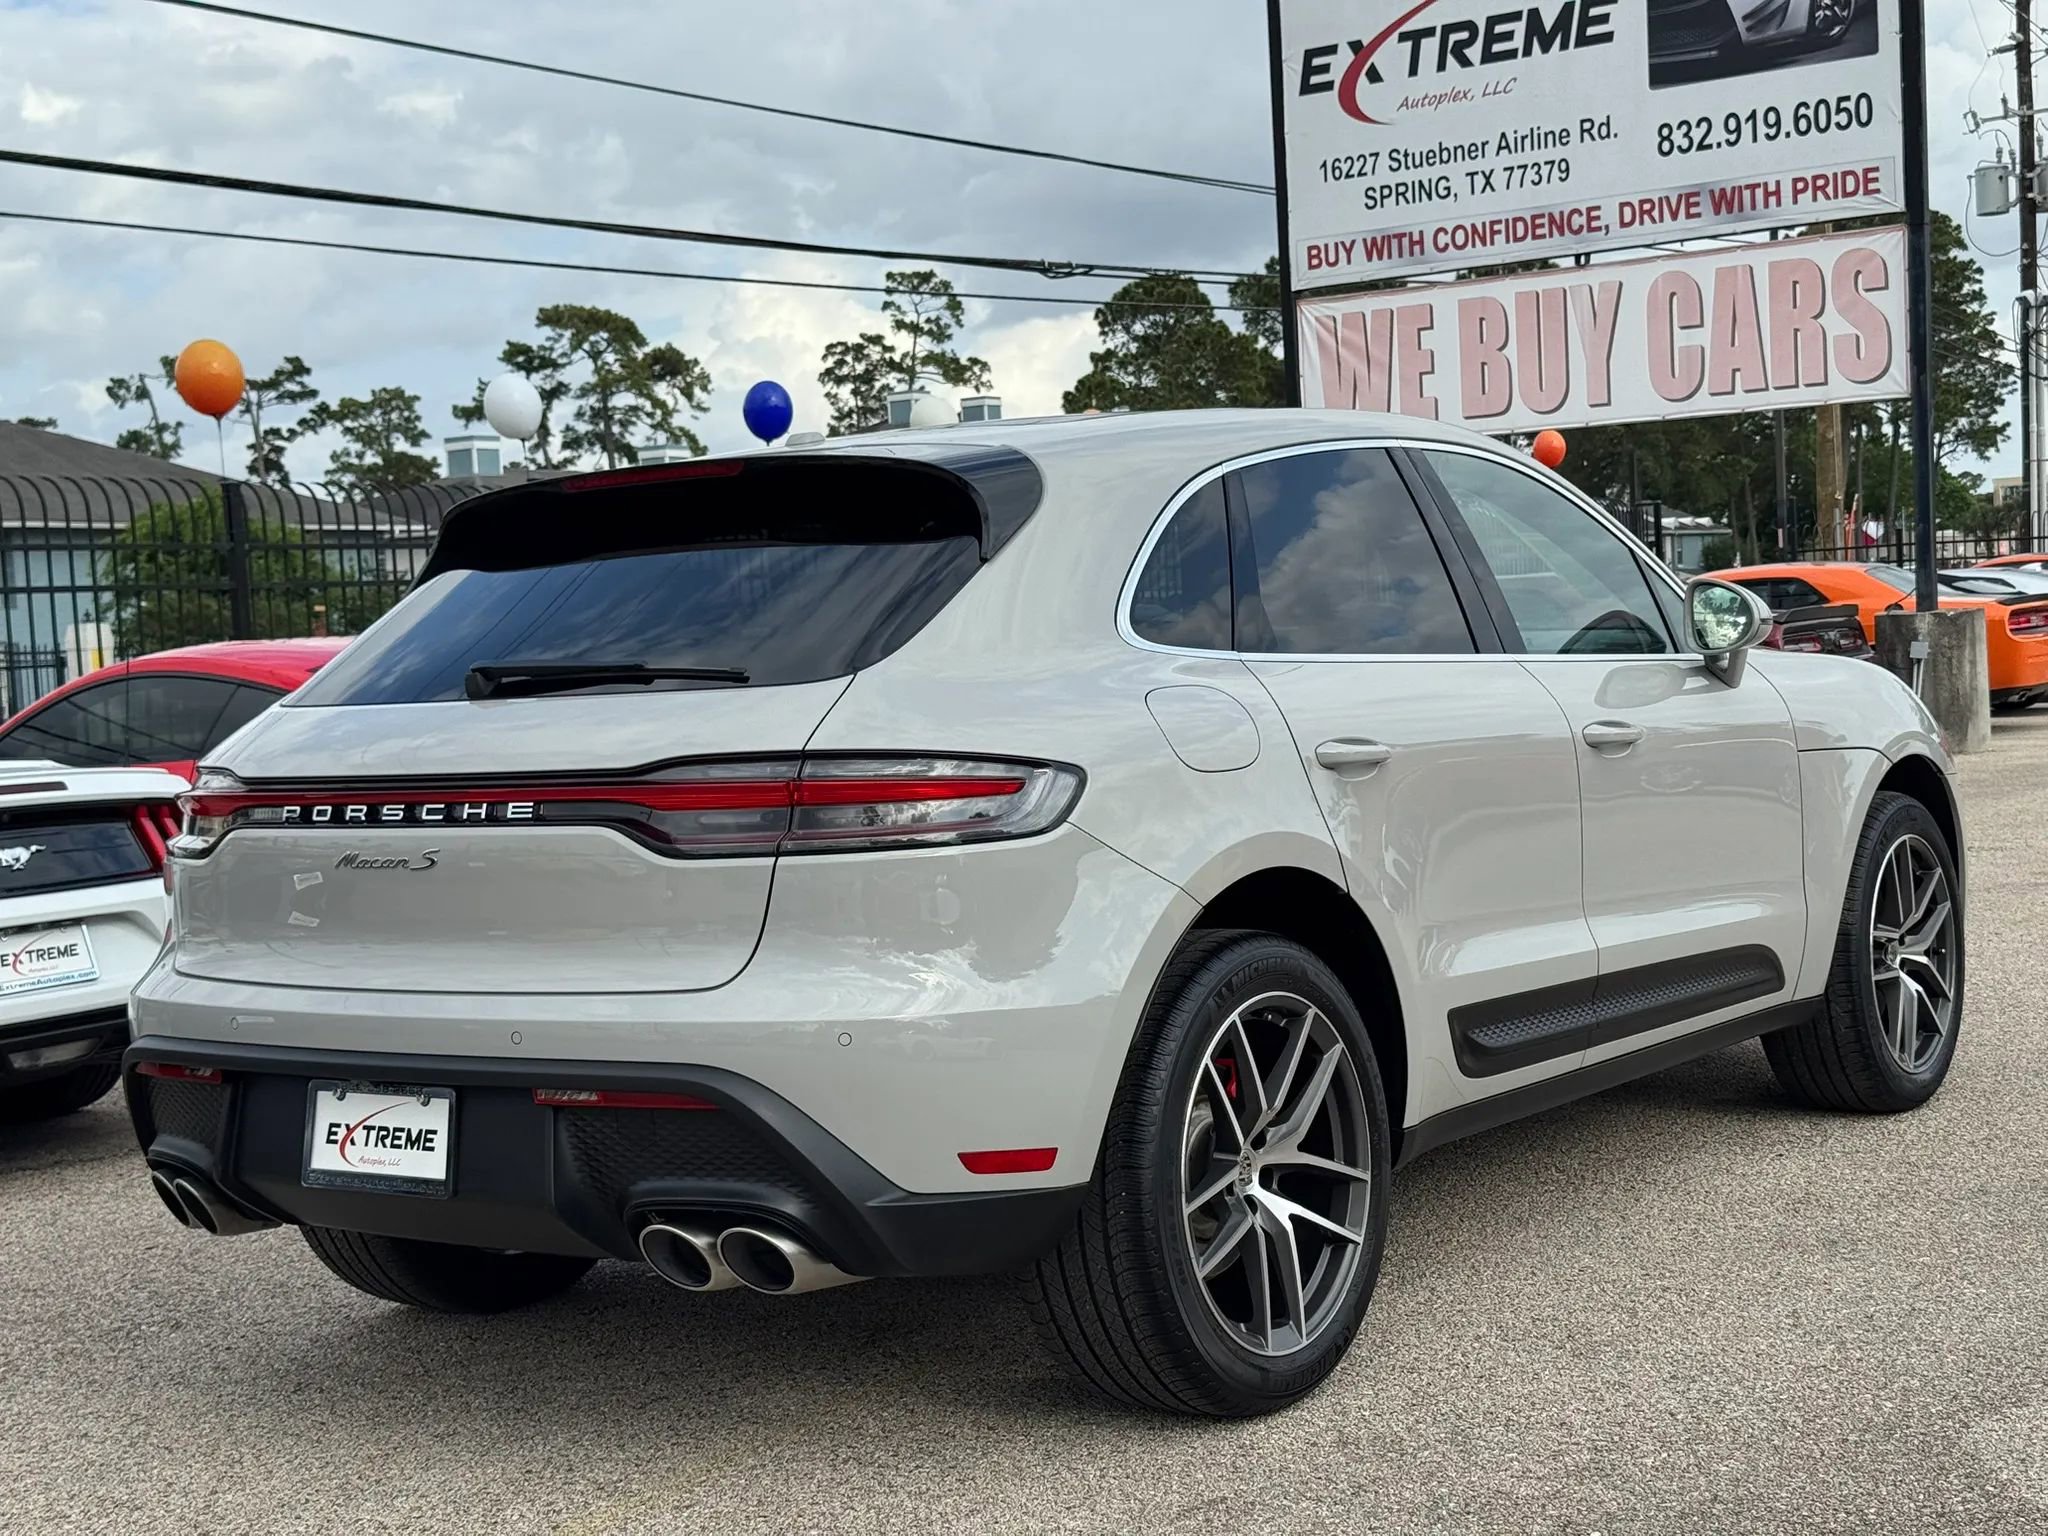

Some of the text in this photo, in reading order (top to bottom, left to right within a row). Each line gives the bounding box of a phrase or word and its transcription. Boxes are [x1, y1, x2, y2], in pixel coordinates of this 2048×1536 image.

[1299, 0, 1618, 97] EXTREME
[1397, 77, 1518, 113] Autoplex, LLC
[1319, 115, 1619, 184] 16227 Stuebner Airline Rd.
[1656, 92, 1874, 158] 832.919.6050
[1364, 158, 1571, 210] SPRING, TX 77379
[1306, 166, 1881, 271] BUY WITH CONFIDENCE, DRIVE WITH PRIDE
[1314, 247, 1892, 420] WE BUY CARS
[282, 802, 534, 823] PORSCHE
[334, 847, 441, 871] Macan S
[0, 943, 79, 968] EXTREME
[325, 1122, 439, 1153] EXTREME
